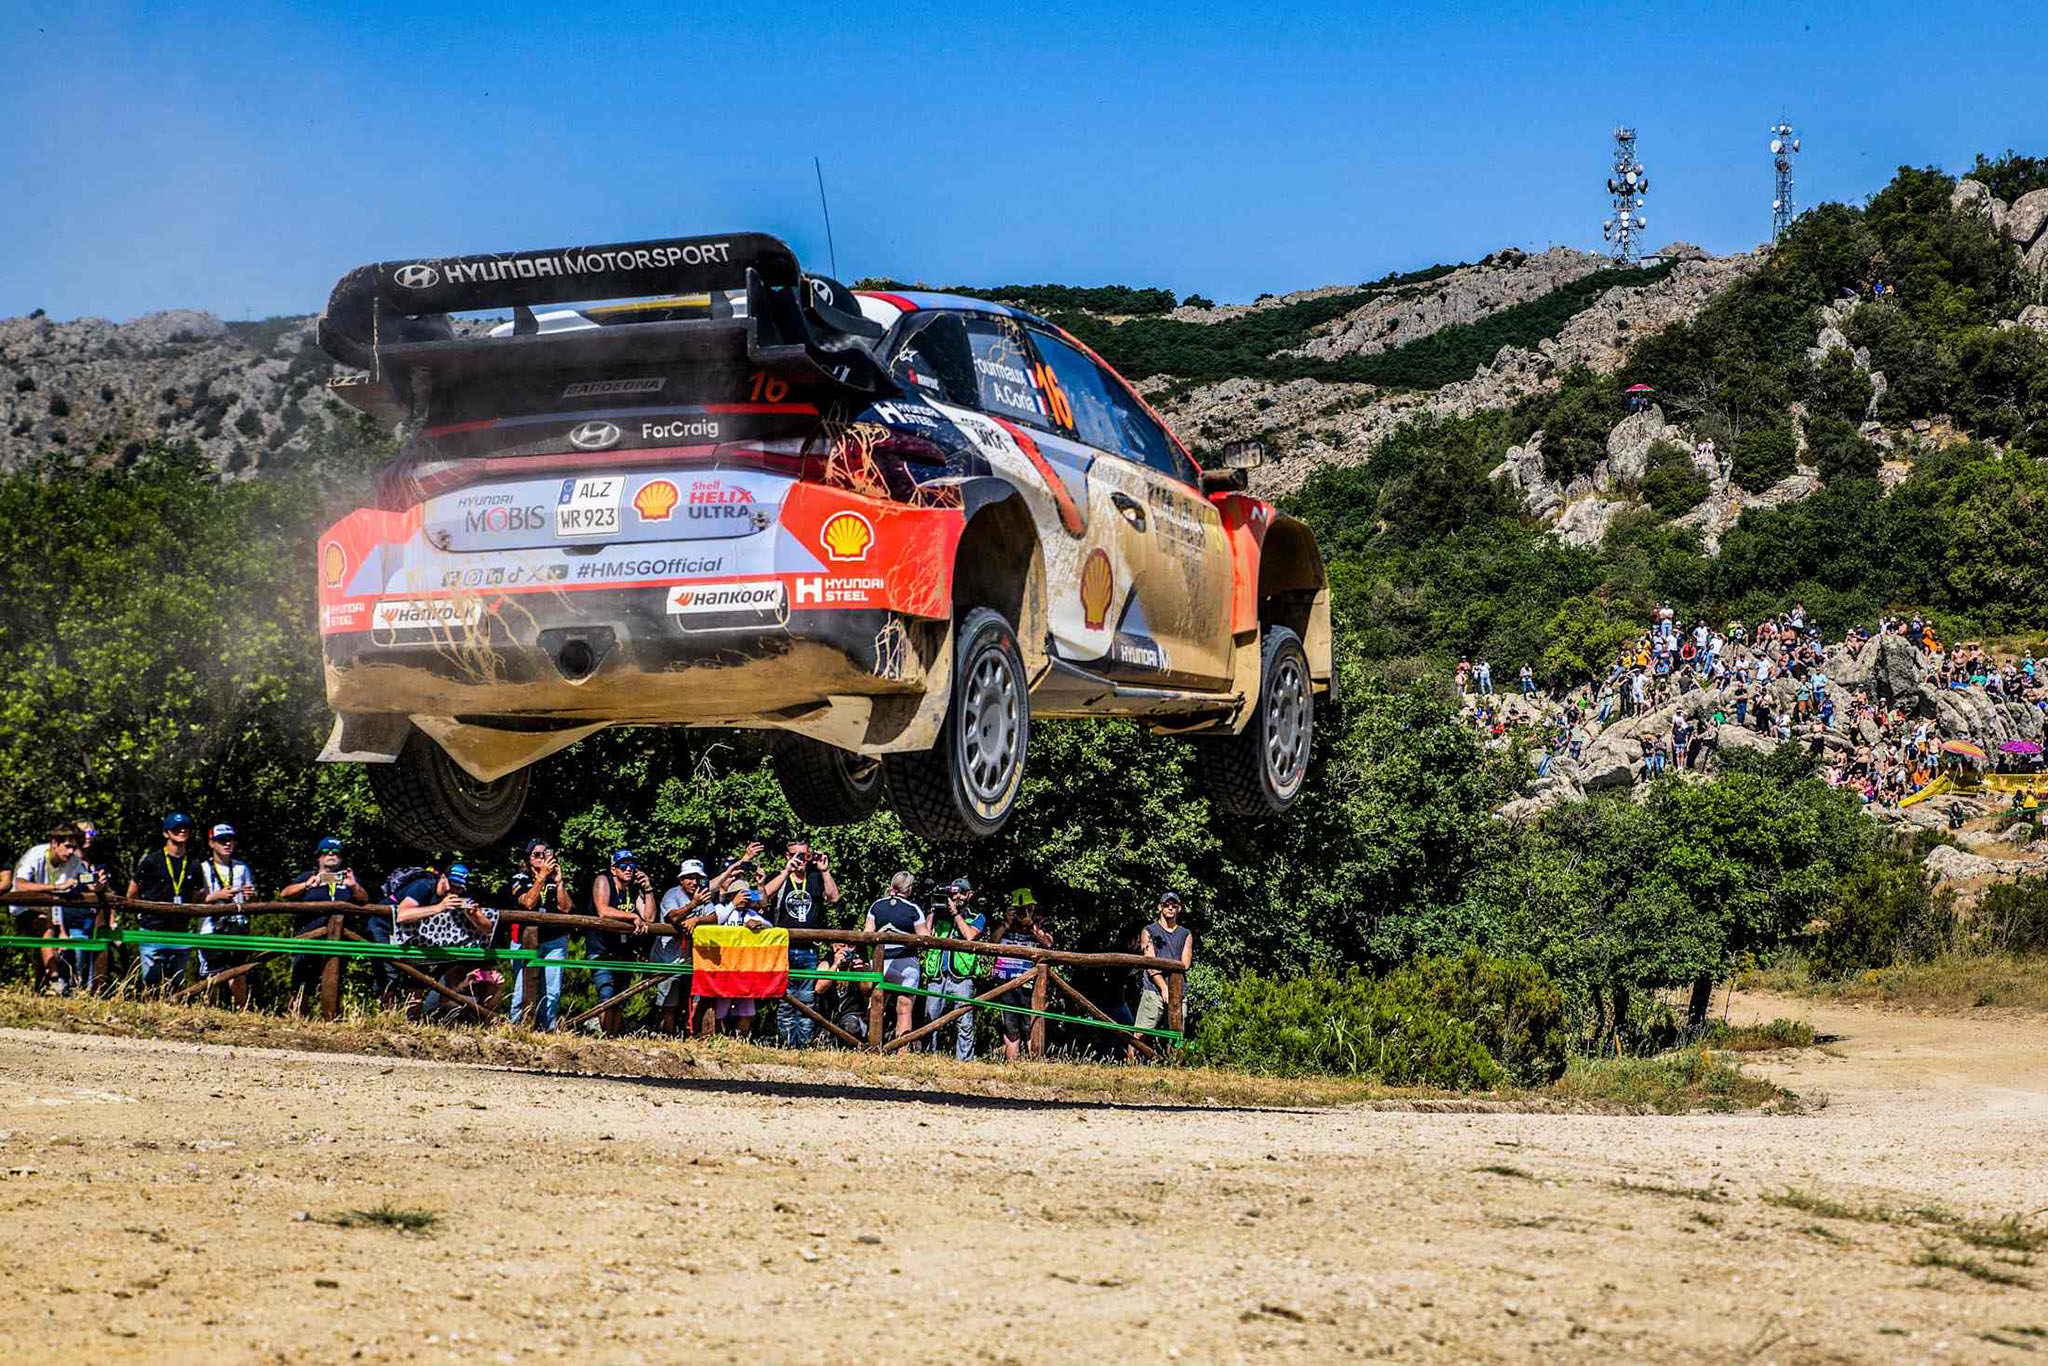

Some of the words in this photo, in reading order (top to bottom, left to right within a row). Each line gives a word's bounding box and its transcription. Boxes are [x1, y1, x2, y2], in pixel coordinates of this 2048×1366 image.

[444, 257, 564, 284] HYUNDAI
[565, 242, 731, 275] MOTORSPORT
[749, 372, 789, 402] 16
[1035, 361, 1073, 430] 16
[642, 418, 719, 439] ForCraig
[579, 481, 612, 498] ALZ
[692, 480, 721, 491] Shell
[458, 495, 514, 507] HYUNDAI
[689, 491, 753, 504] HELIX
[465, 505, 545, 533] MOBIS
[560, 509, 582, 529] WR
[584, 507, 615, 528] 923
[688, 505, 749, 519] ULTRA
[577, 557, 723, 579] #HMSGOfficial
[824, 578, 884, 589] HYUNDAI
[824, 592, 869, 602] STEEL
